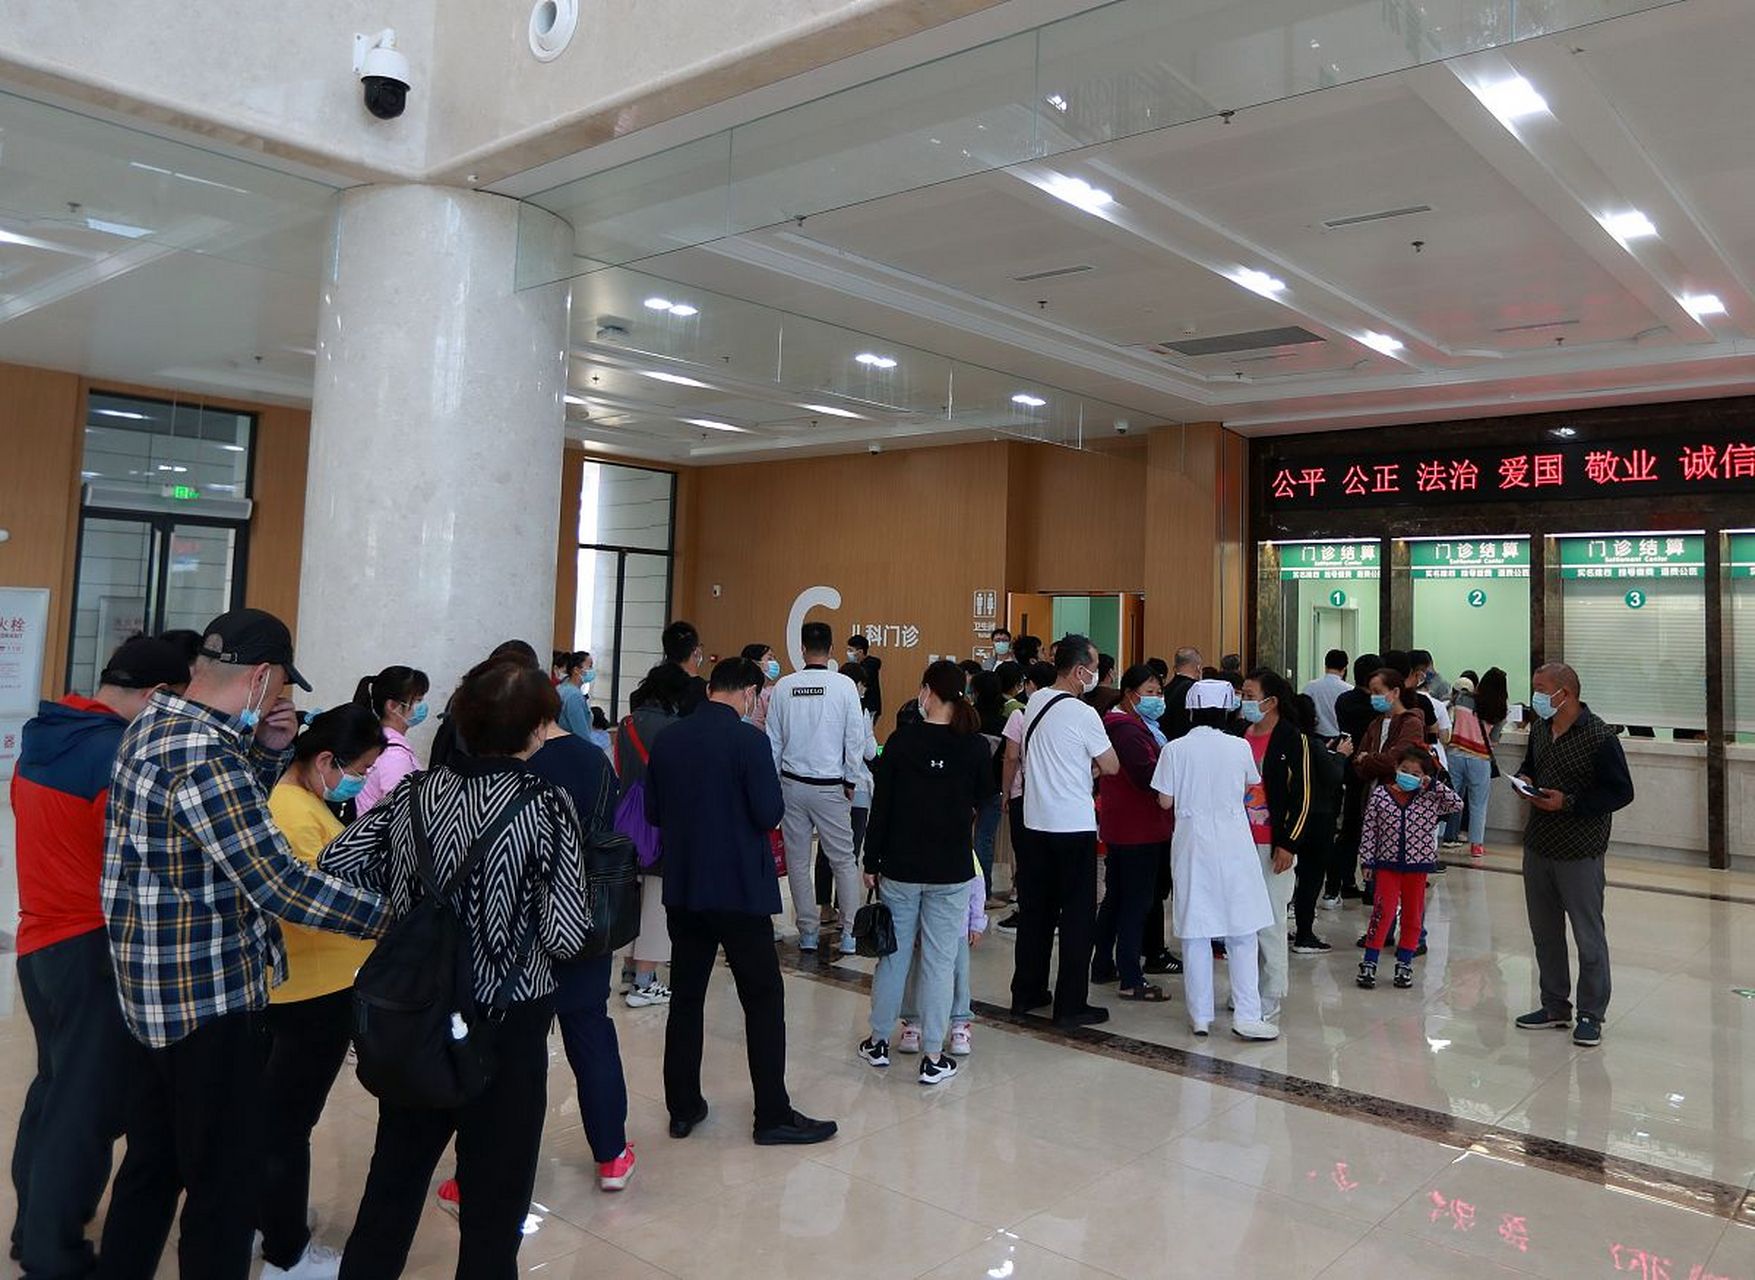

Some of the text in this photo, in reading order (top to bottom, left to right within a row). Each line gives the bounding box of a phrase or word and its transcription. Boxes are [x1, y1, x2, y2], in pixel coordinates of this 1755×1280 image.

[1271, 443, 1755, 498] 公平 公正 法治 爱国 敬业 诚信
[1302, 545, 1376, 561] 门诊结算
[1435, 541, 1519, 559] 门诊结算
[1588, 538, 1685, 558] 门诊结算
[1333, 592, 1341, 605] 1
[1472, 591, 1482, 605] 2
[1630, 591, 1641, 606] 3
